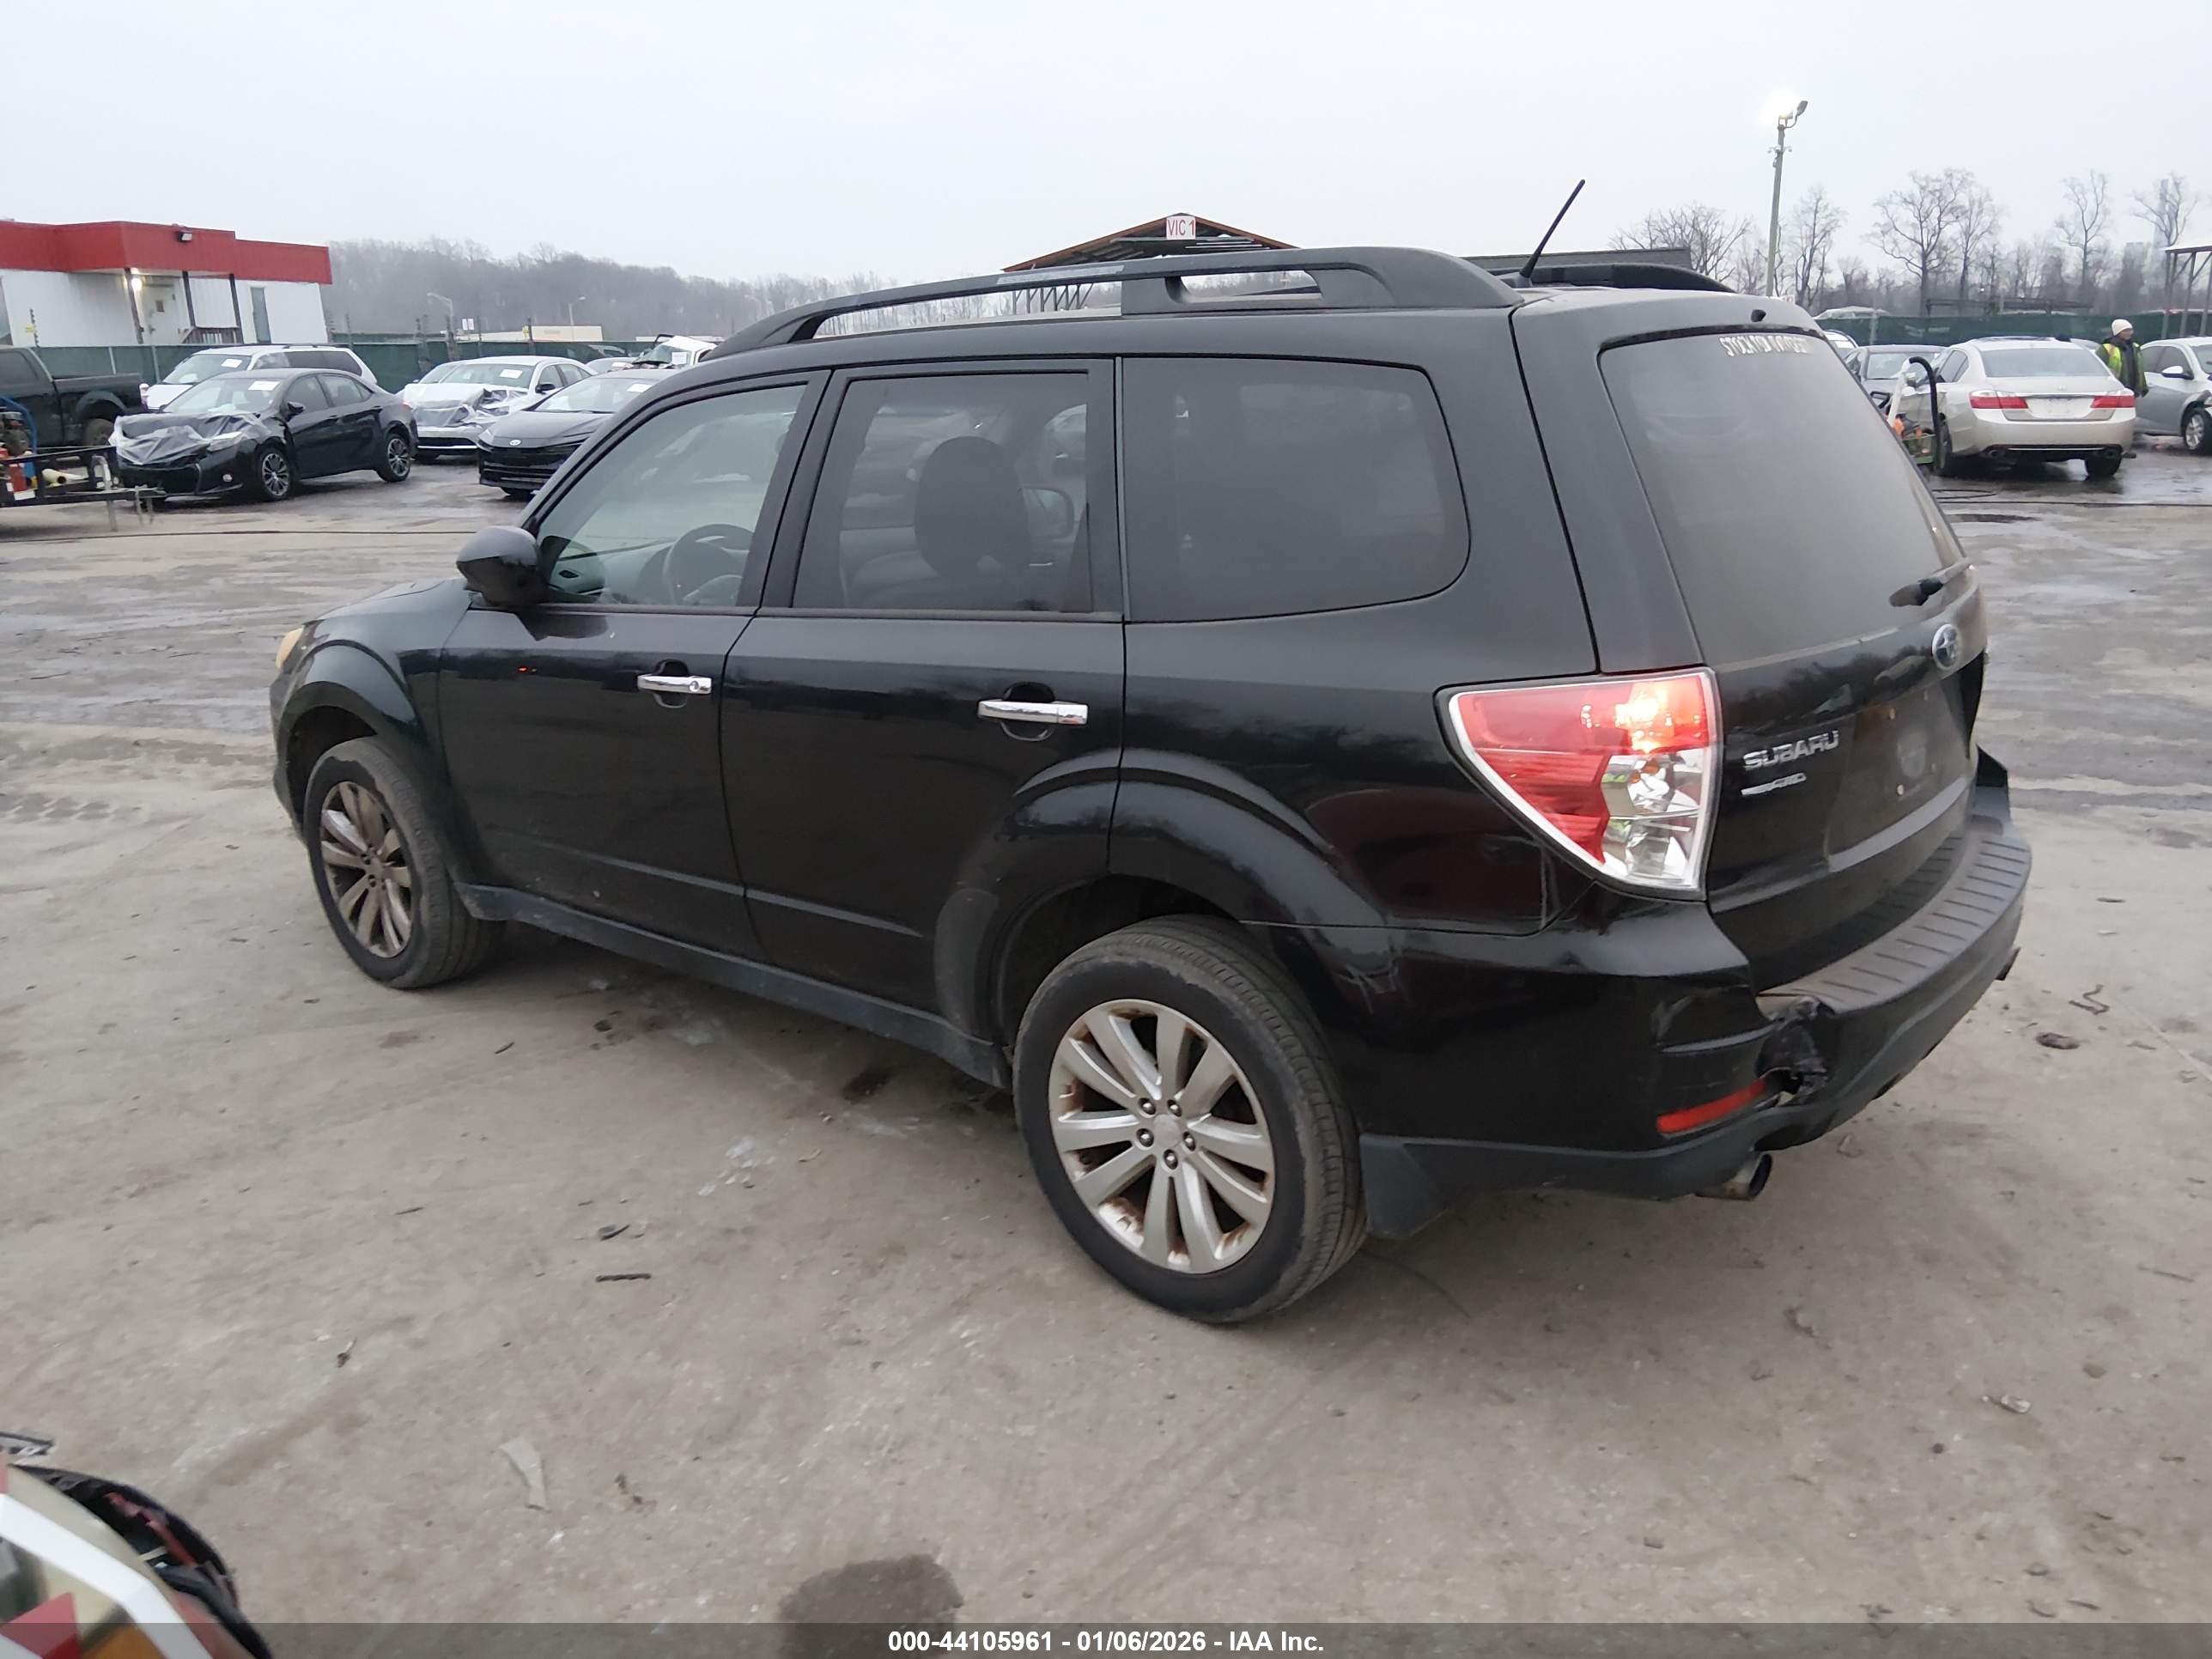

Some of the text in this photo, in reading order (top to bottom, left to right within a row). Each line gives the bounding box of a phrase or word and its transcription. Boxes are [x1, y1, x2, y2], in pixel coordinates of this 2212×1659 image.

[1167, 219, 1194, 236] VIC 1
[1743, 730, 1839, 771] SUBARU
